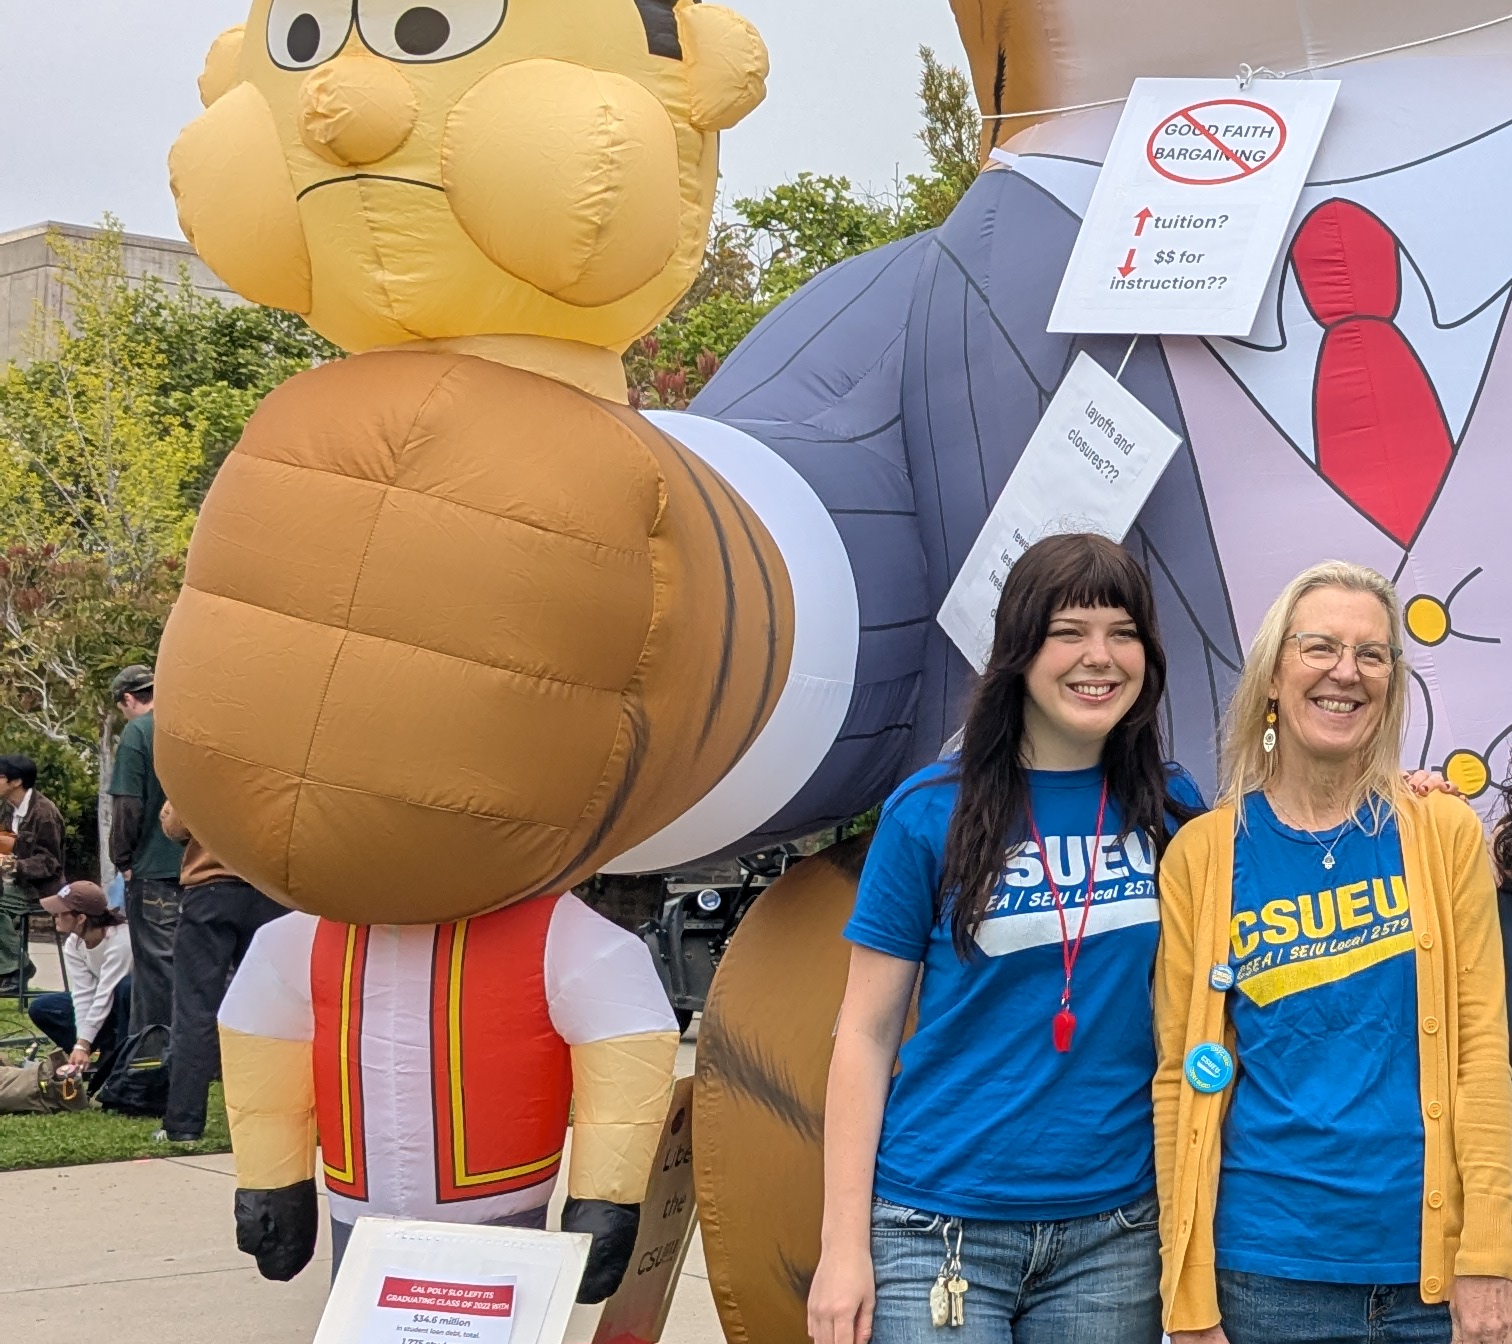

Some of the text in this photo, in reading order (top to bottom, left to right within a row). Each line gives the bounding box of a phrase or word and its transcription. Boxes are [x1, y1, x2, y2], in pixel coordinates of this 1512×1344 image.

[1164, 123, 1275, 140] GOOD FAITH
[1154, 147, 1267, 163] BARGAINING
[1154, 214, 1229, 230] tuition?
[1154, 250, 1205, 266] $$ for
[1109, 276, 1228, 290] instruction??
[1085, 400, 1136, 456] layoffs and
[1067, 427, 1120, 484] closures???
[1012, 528, 1031, 552] fewe
[989, 570, 1003, 592] free
[984, 826, 1157, 892] SUEU
[1075, 885, 1118, 903] Local
[1231, 876, 1410, 959] CSUEU
[1237, 951, 1272, 980] CSEA
[1290, 941, 1327, 960] SEIU
[1330, 929, 1368, 953] Local
[1371, 918, 1409, 940] 2579
[662, 1144, 692, 1172] Libe
[386, 1294, 435, 1305] GRADUATING
[411, 1285, 425, 1293] CAL
[427, 1287, 446, 1296] POLY
[448, 1289, 463, 1297] SLO
[464, 1290, 481, 1298] LEFT
[413, 1314, 471, 1327] $34.6 million
